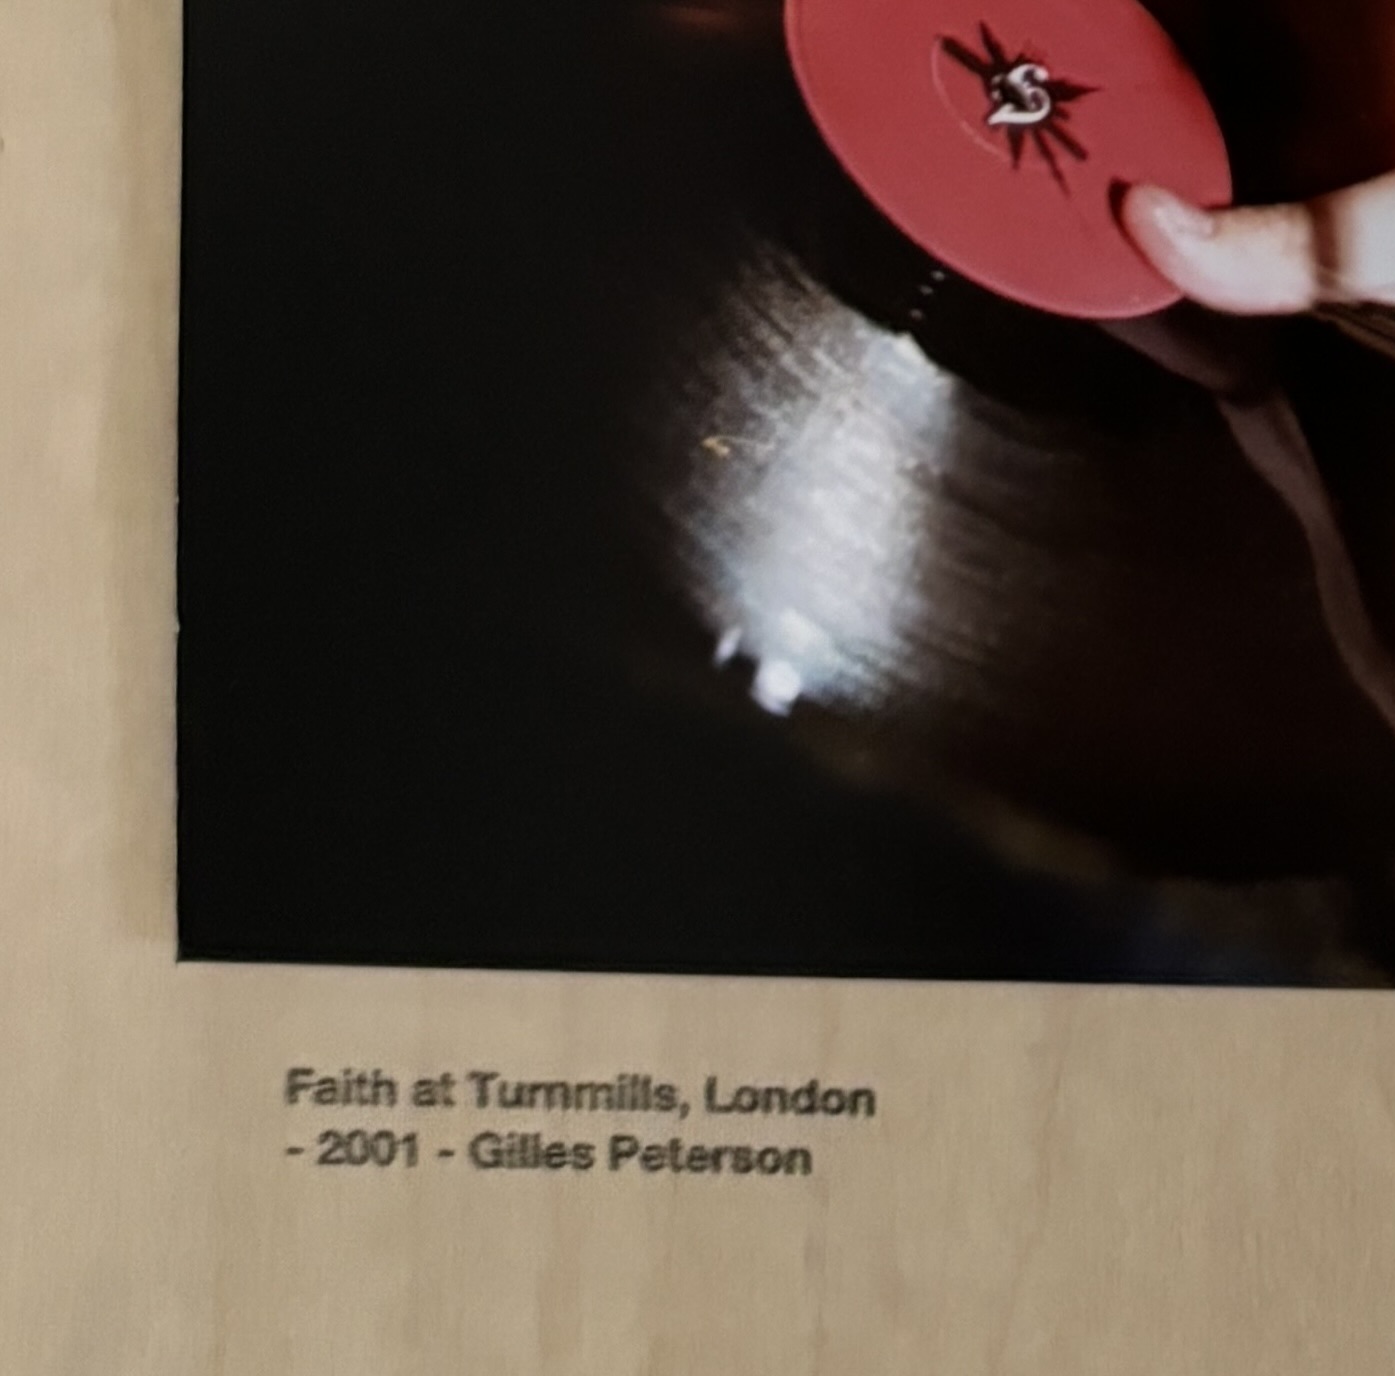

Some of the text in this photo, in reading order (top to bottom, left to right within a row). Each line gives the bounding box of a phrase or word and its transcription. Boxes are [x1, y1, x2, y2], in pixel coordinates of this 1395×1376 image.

[284, 1067, 397, 1108] Faith
[411, 1072, 456, 1108] at
[703, 1076, 877, 1117] London
[316, 1130, 419, 1168] 2001
[467, 1131, 596, 1170] Gilles
[609, 1135, 813, 1175] Peterson
